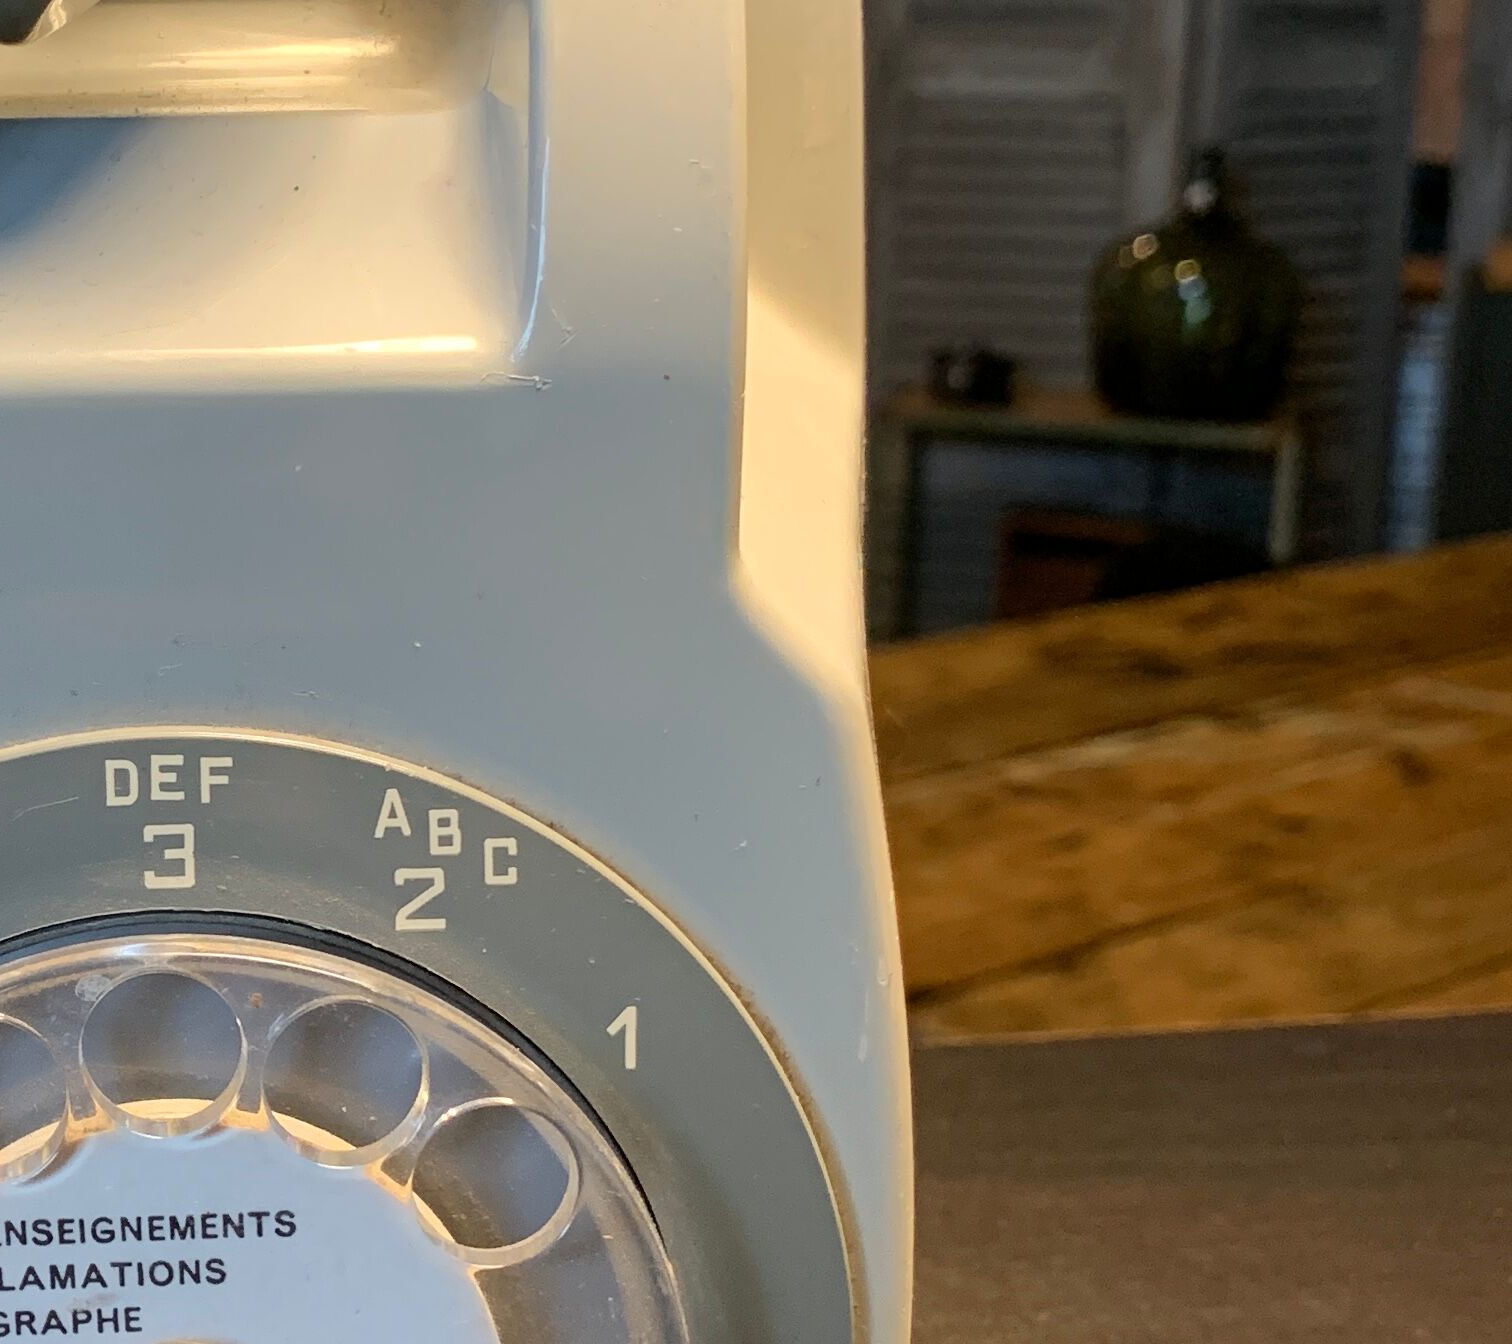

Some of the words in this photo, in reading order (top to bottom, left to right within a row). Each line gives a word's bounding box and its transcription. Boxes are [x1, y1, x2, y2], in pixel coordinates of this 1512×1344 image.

[144, 823, 196, 889] 3
[394, 867, 446, 931] 2
[606, 1005, 637, 1070] 1
